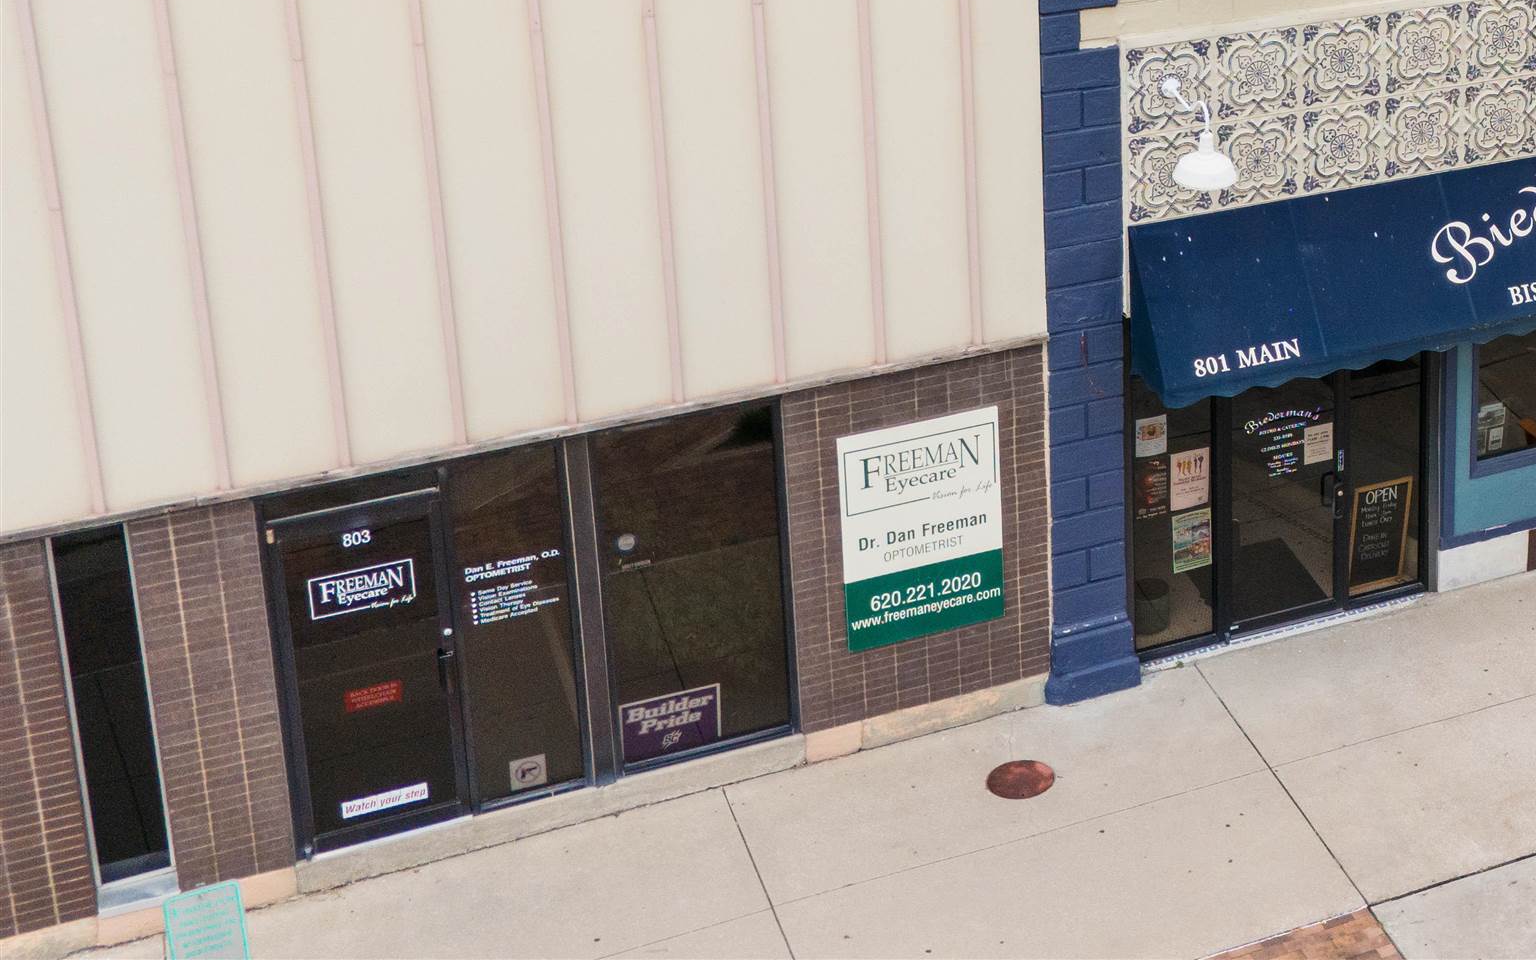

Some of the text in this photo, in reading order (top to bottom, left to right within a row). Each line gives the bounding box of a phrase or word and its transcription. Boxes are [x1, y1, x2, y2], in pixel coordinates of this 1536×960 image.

[1194, 338, 1301, 378] 801 MAIN
[1244, 406, 1320, 435] Biederman's
[860, 434, 981, 490] FREEMAN
[884, 466, 957, 495] Eyecare
[1365, 485, 1398, 505] OPEN
[342, 529, 371, 548] 803
[859, 512, 987, 551] Dr. Dan Freeman
[464, 549, 560, 576] Dan E. Freeman, O.D.
[884, 535, 964, 562] OPTOMETRIST
[319, 566, 404, 604] FREEMAN
[465, 563, 531, 582] OPTOMETRIST
[338, 587, 388, 606] Eyecare
[870, 572, 982, 611] 620.221.2020
[851, 586, 1001, 631] www.freemaneyecare.com
[625, 695, 713, 724] Builder
[639, 711, 701, 735] Pride
[345, 788, 425, 815] Watch your step
